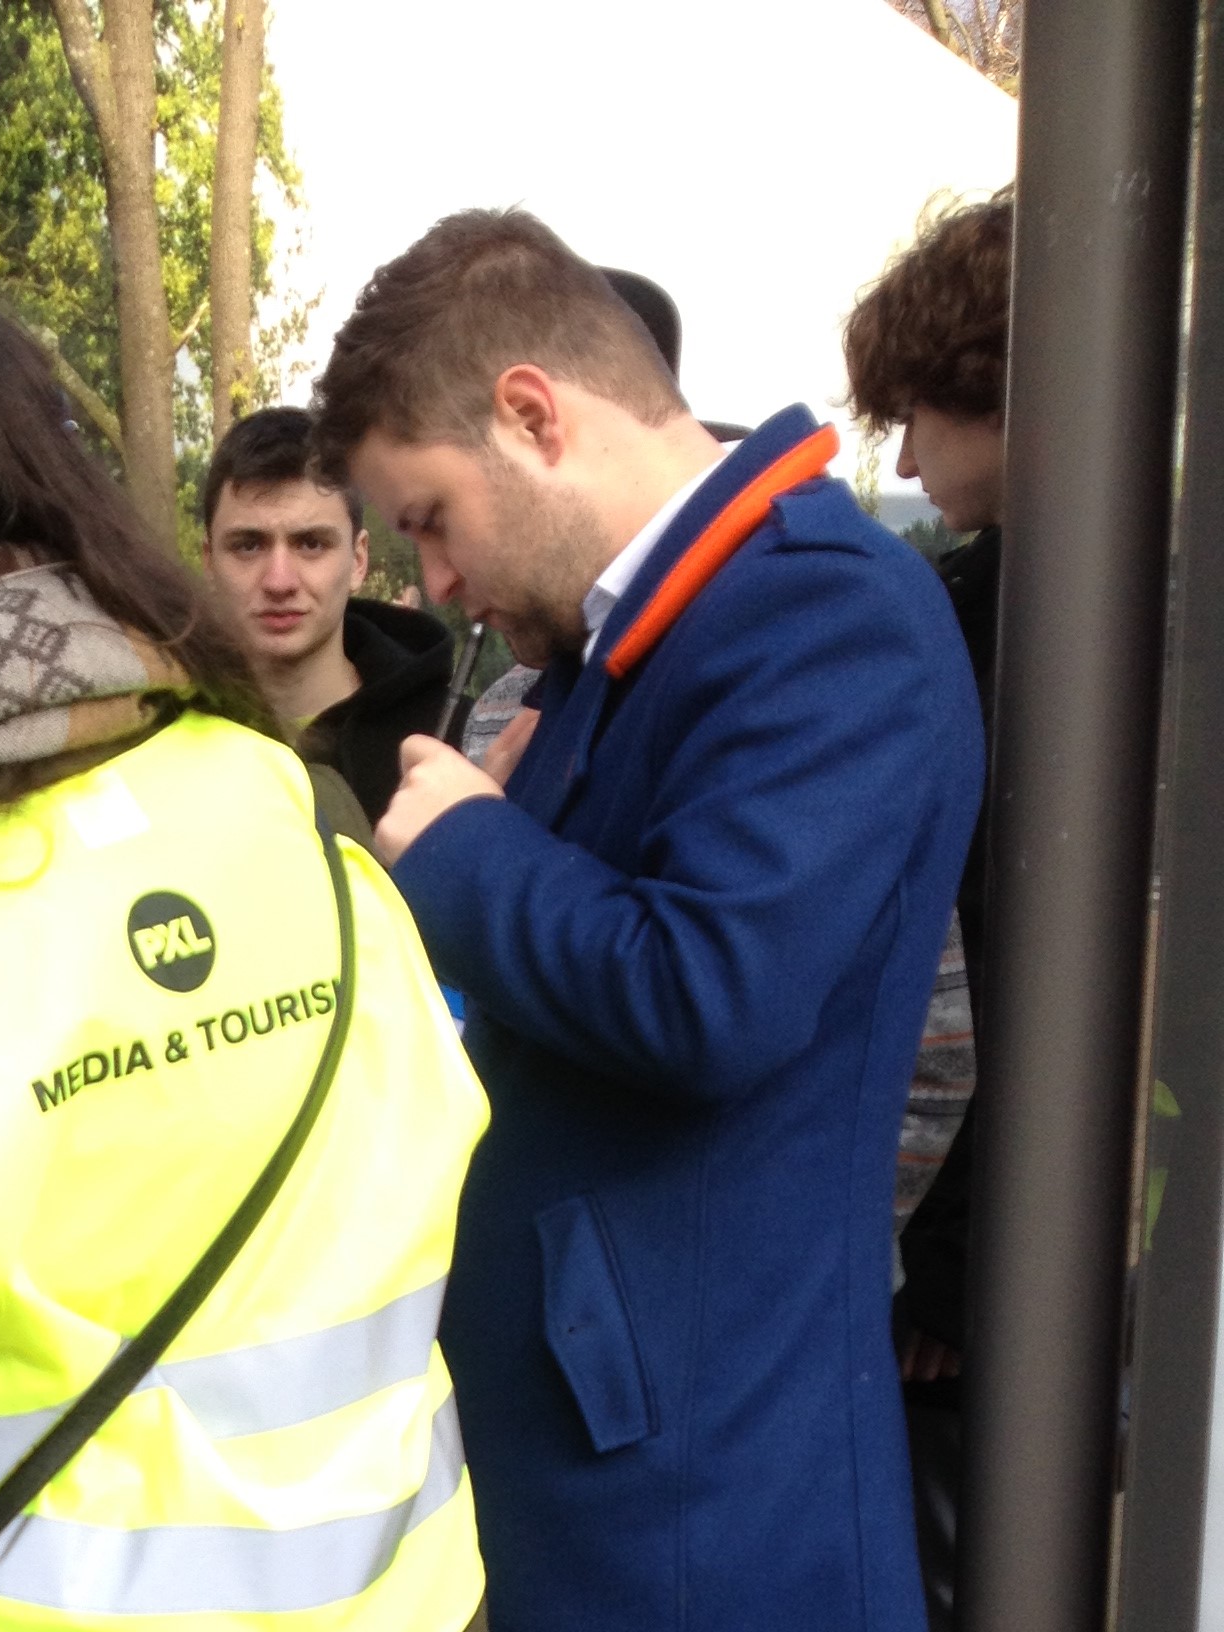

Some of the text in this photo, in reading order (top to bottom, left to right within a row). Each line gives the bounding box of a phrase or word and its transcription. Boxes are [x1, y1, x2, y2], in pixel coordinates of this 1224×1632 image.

[132, 914, 213, 971] PXL
[32, 978, 341, 1113] MEDIA & TOURIS
